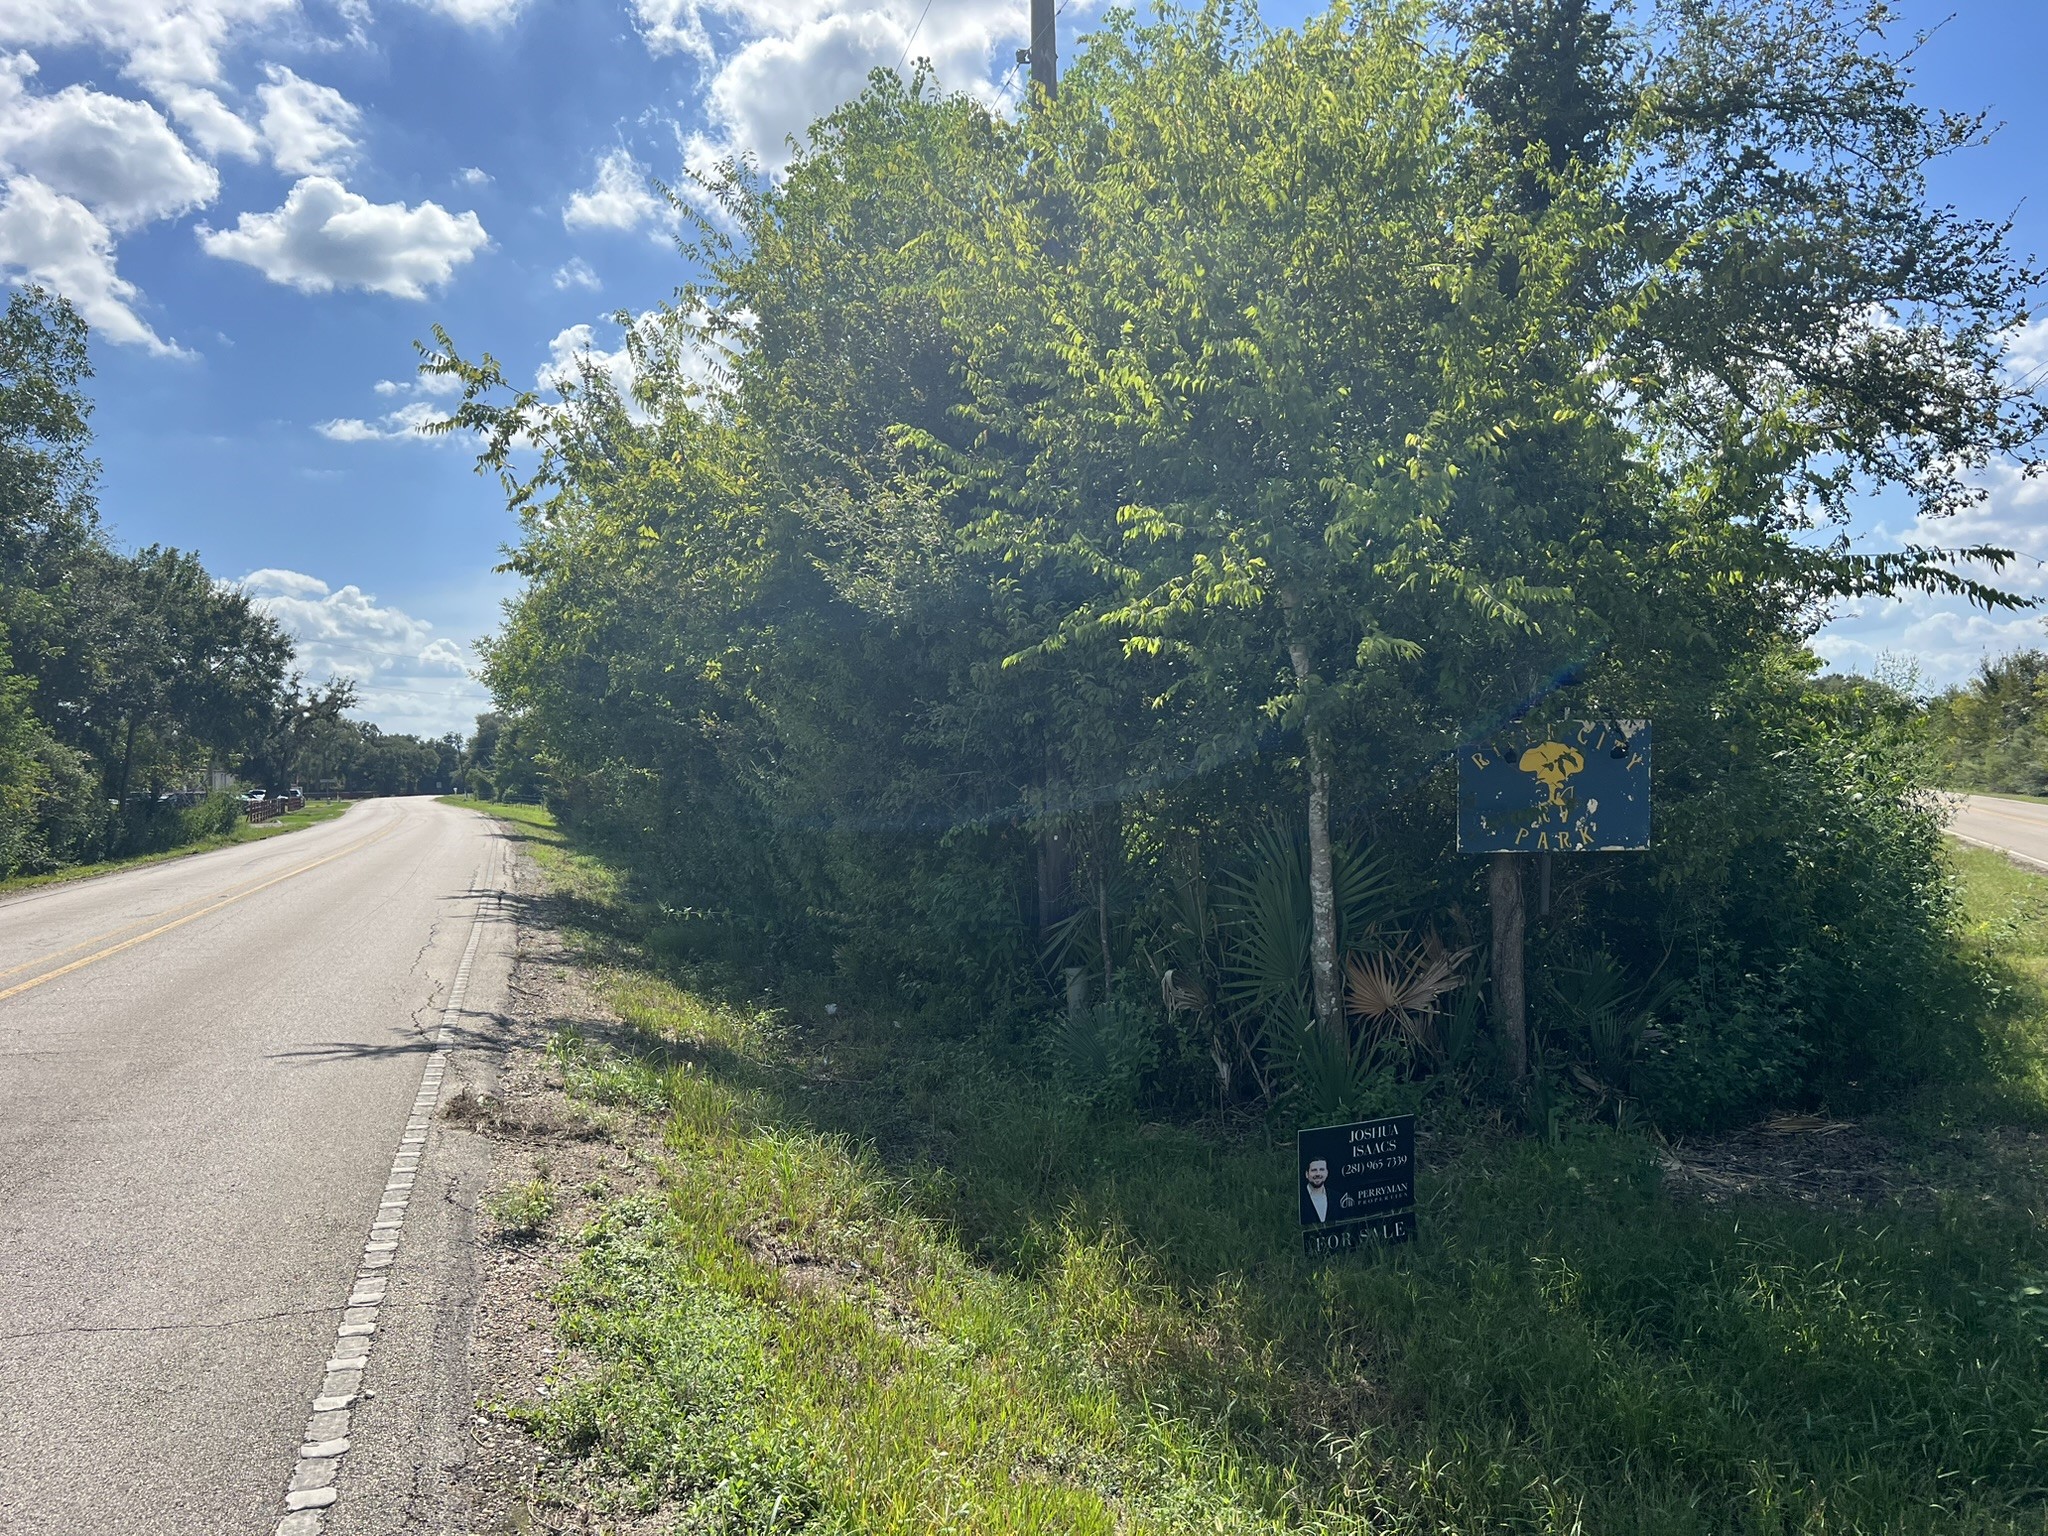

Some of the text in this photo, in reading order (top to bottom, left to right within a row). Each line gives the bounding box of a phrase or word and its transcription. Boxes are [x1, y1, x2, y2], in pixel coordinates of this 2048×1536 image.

[1514, 826, 1594, 850] PARK
[1350, 1124, 1399, 1143] JOSHUA
[1354, 1140, 1397, 1158] ISAACS
[1341, 1154, 1408, 1177] (281) 965 7339
[1358, 1182, 1409, 1199] PERRYMAN
[1316, 1231, 1352, 1252] FOR
